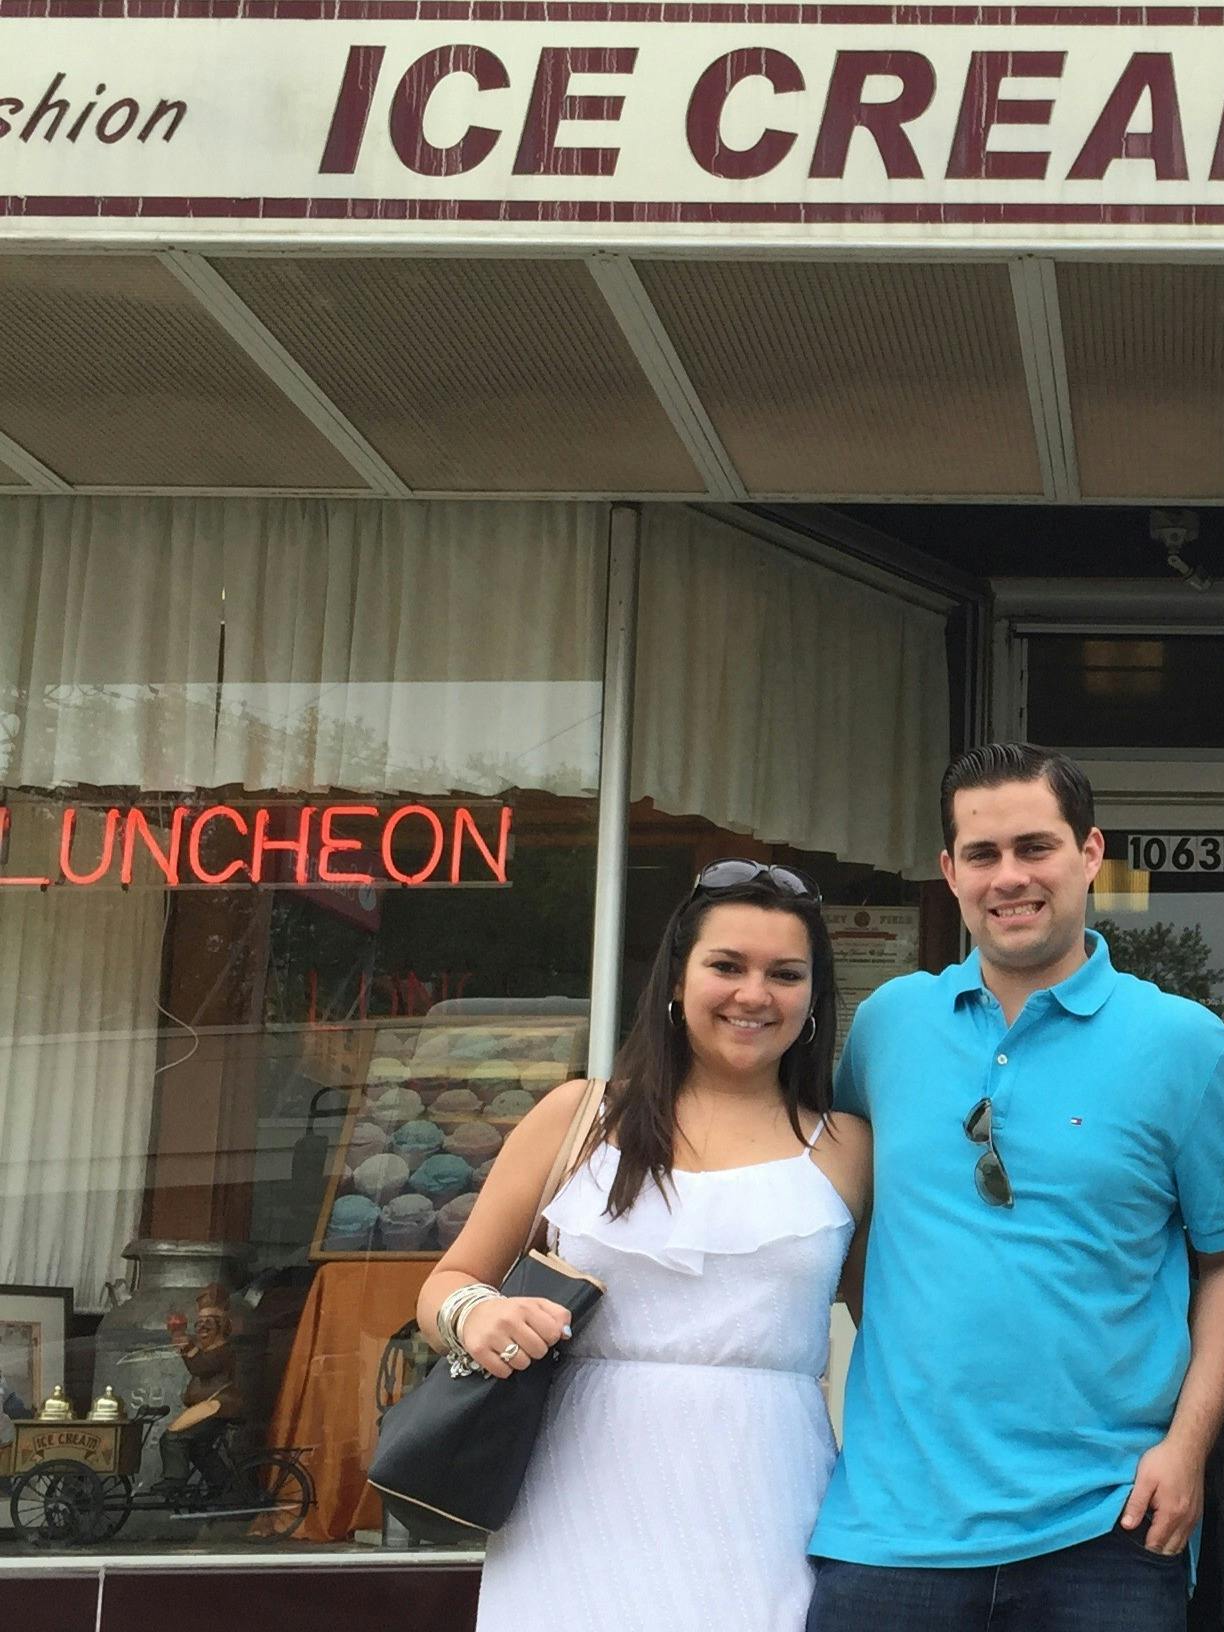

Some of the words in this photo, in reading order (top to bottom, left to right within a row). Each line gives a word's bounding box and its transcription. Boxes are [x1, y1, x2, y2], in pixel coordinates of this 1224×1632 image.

[318, 44, 640, 178] ICE
[0, 804, 513, 887] LUNCHEON
[1129, 836, 1222, 871] 1063
